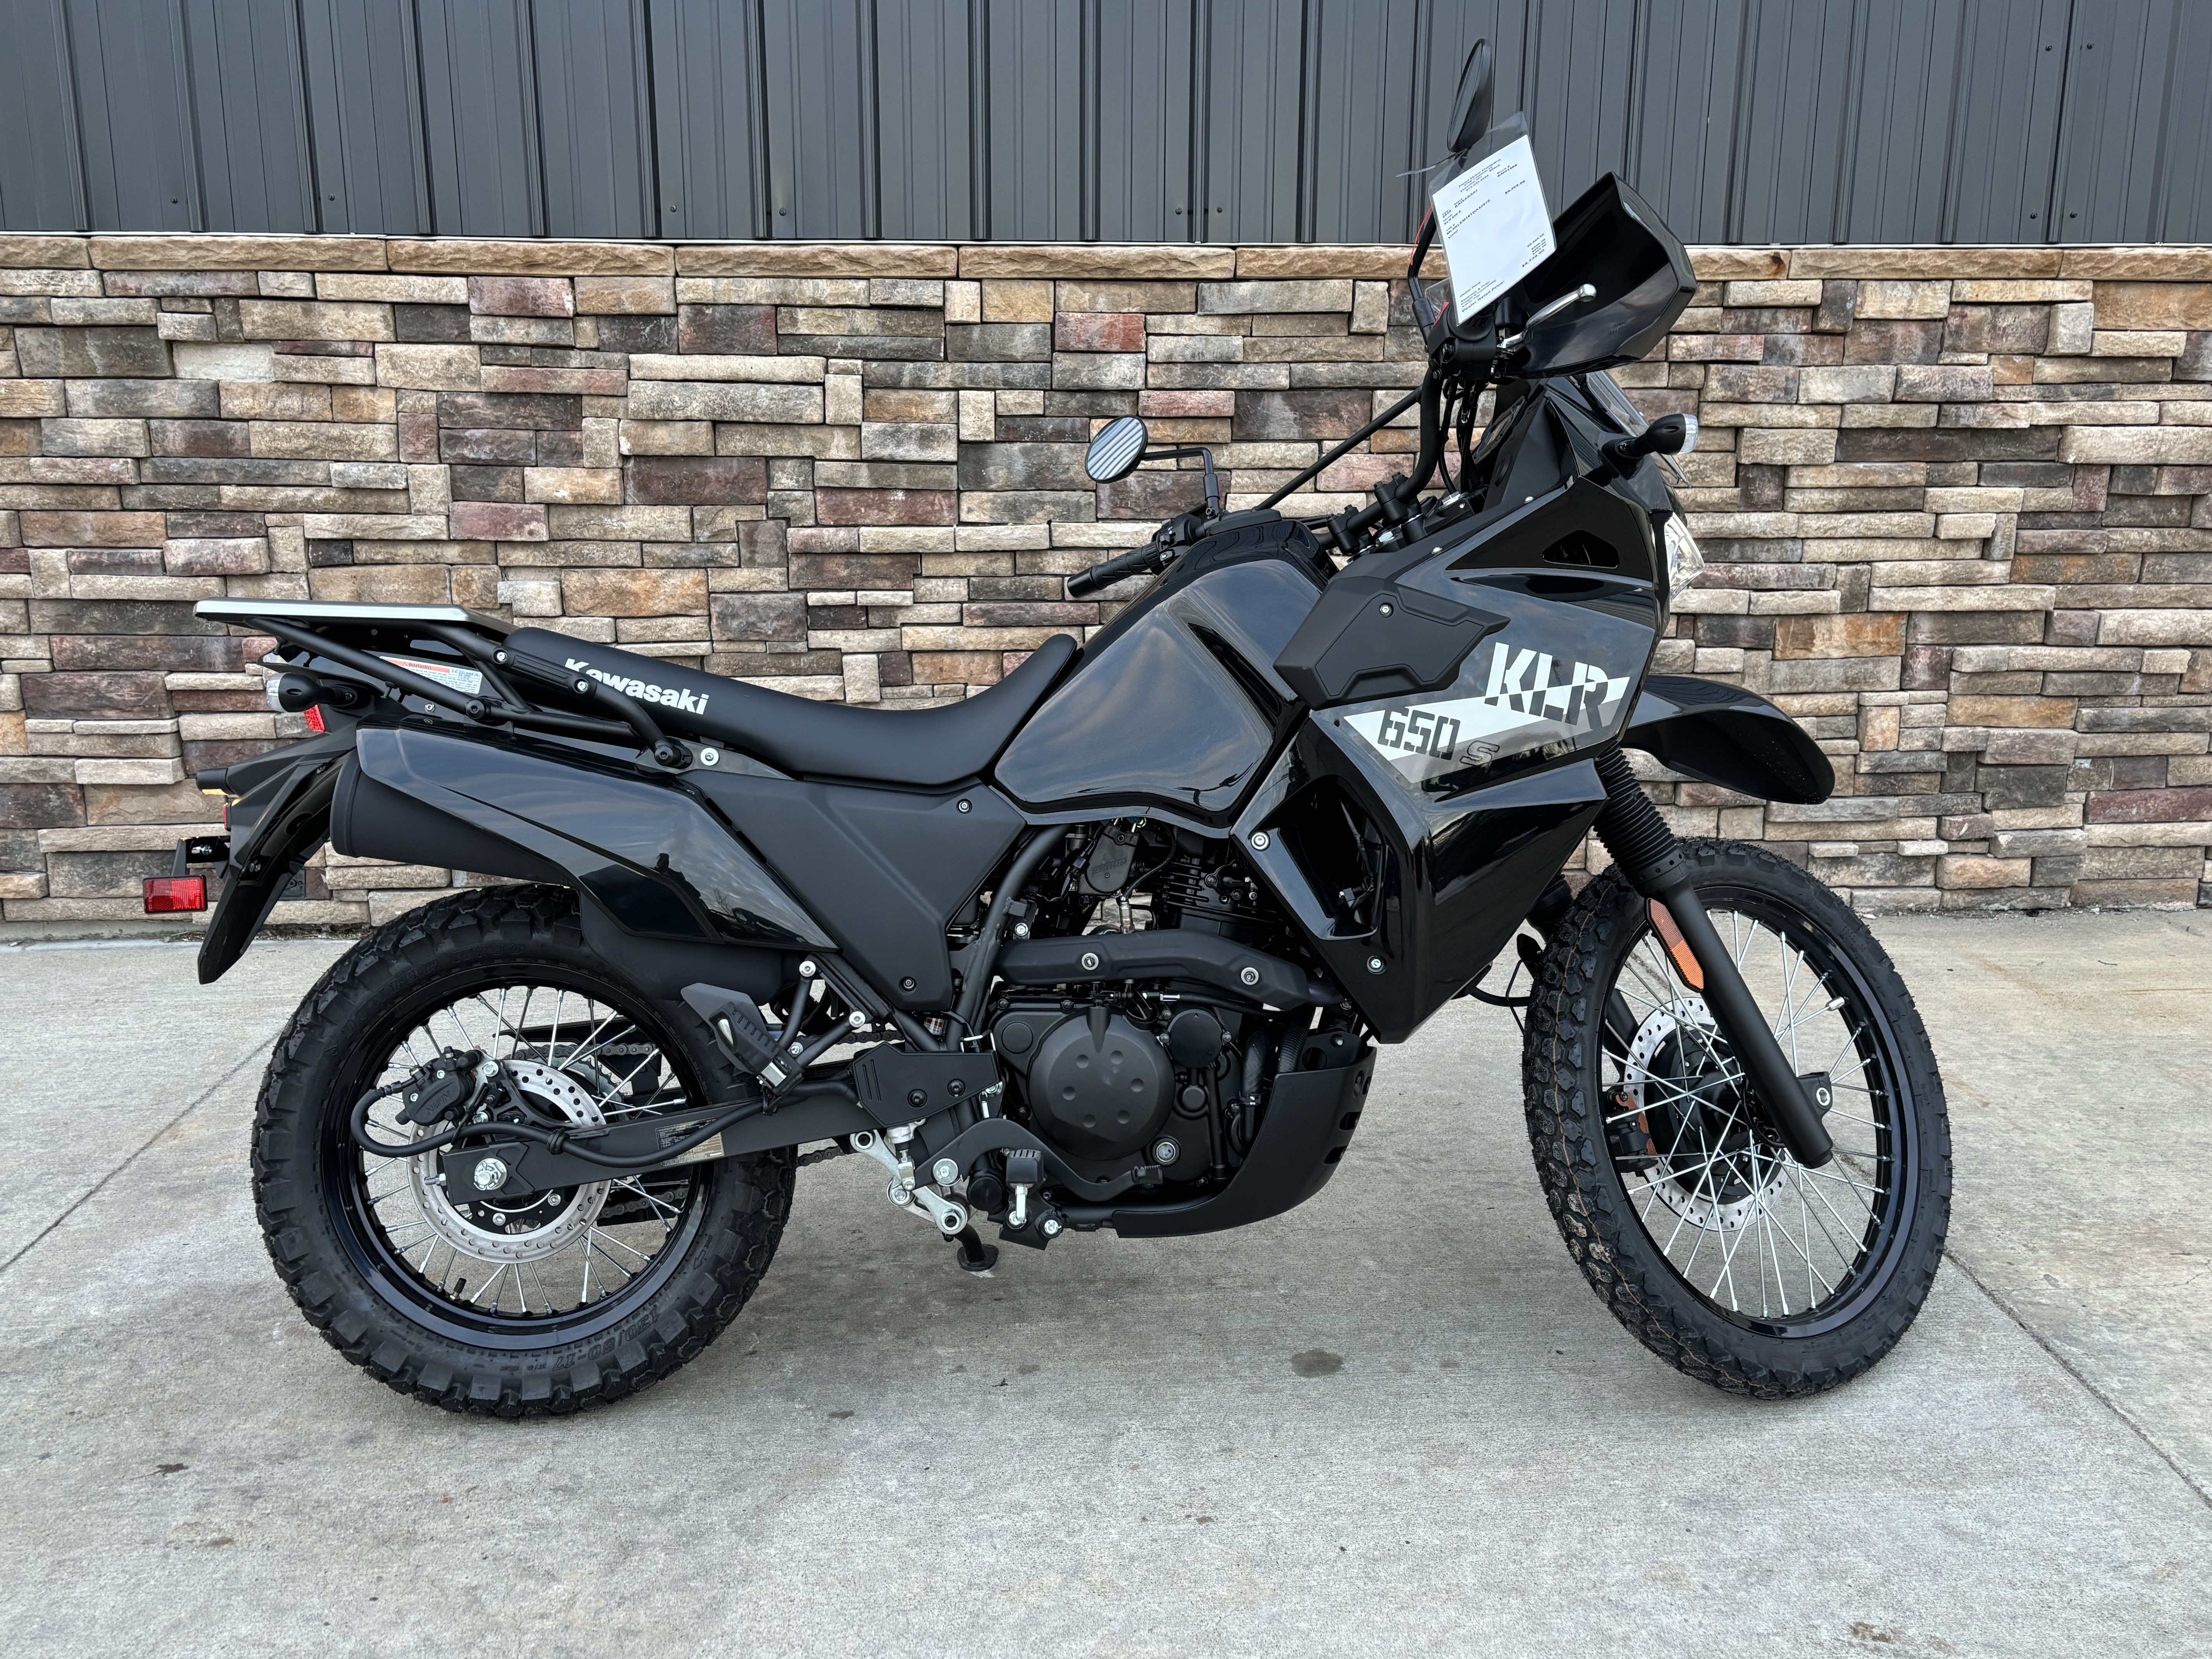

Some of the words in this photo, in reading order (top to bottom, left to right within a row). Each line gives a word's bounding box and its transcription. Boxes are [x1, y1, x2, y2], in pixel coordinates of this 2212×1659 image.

[1455, 189, 1477, 208] KAWASAKI
[565, 658, 709, 715] Kawasaki
[1485, 642, 1608, 730] KLR
[1377, 707, 1461, 760] 650
[1460, 740, 1500, 766] S
[342, 958, 438, 1037] DUNLOP
[452, 943, 526, 963] K750
[552, 1306, 659, 1372] 130/80-17
